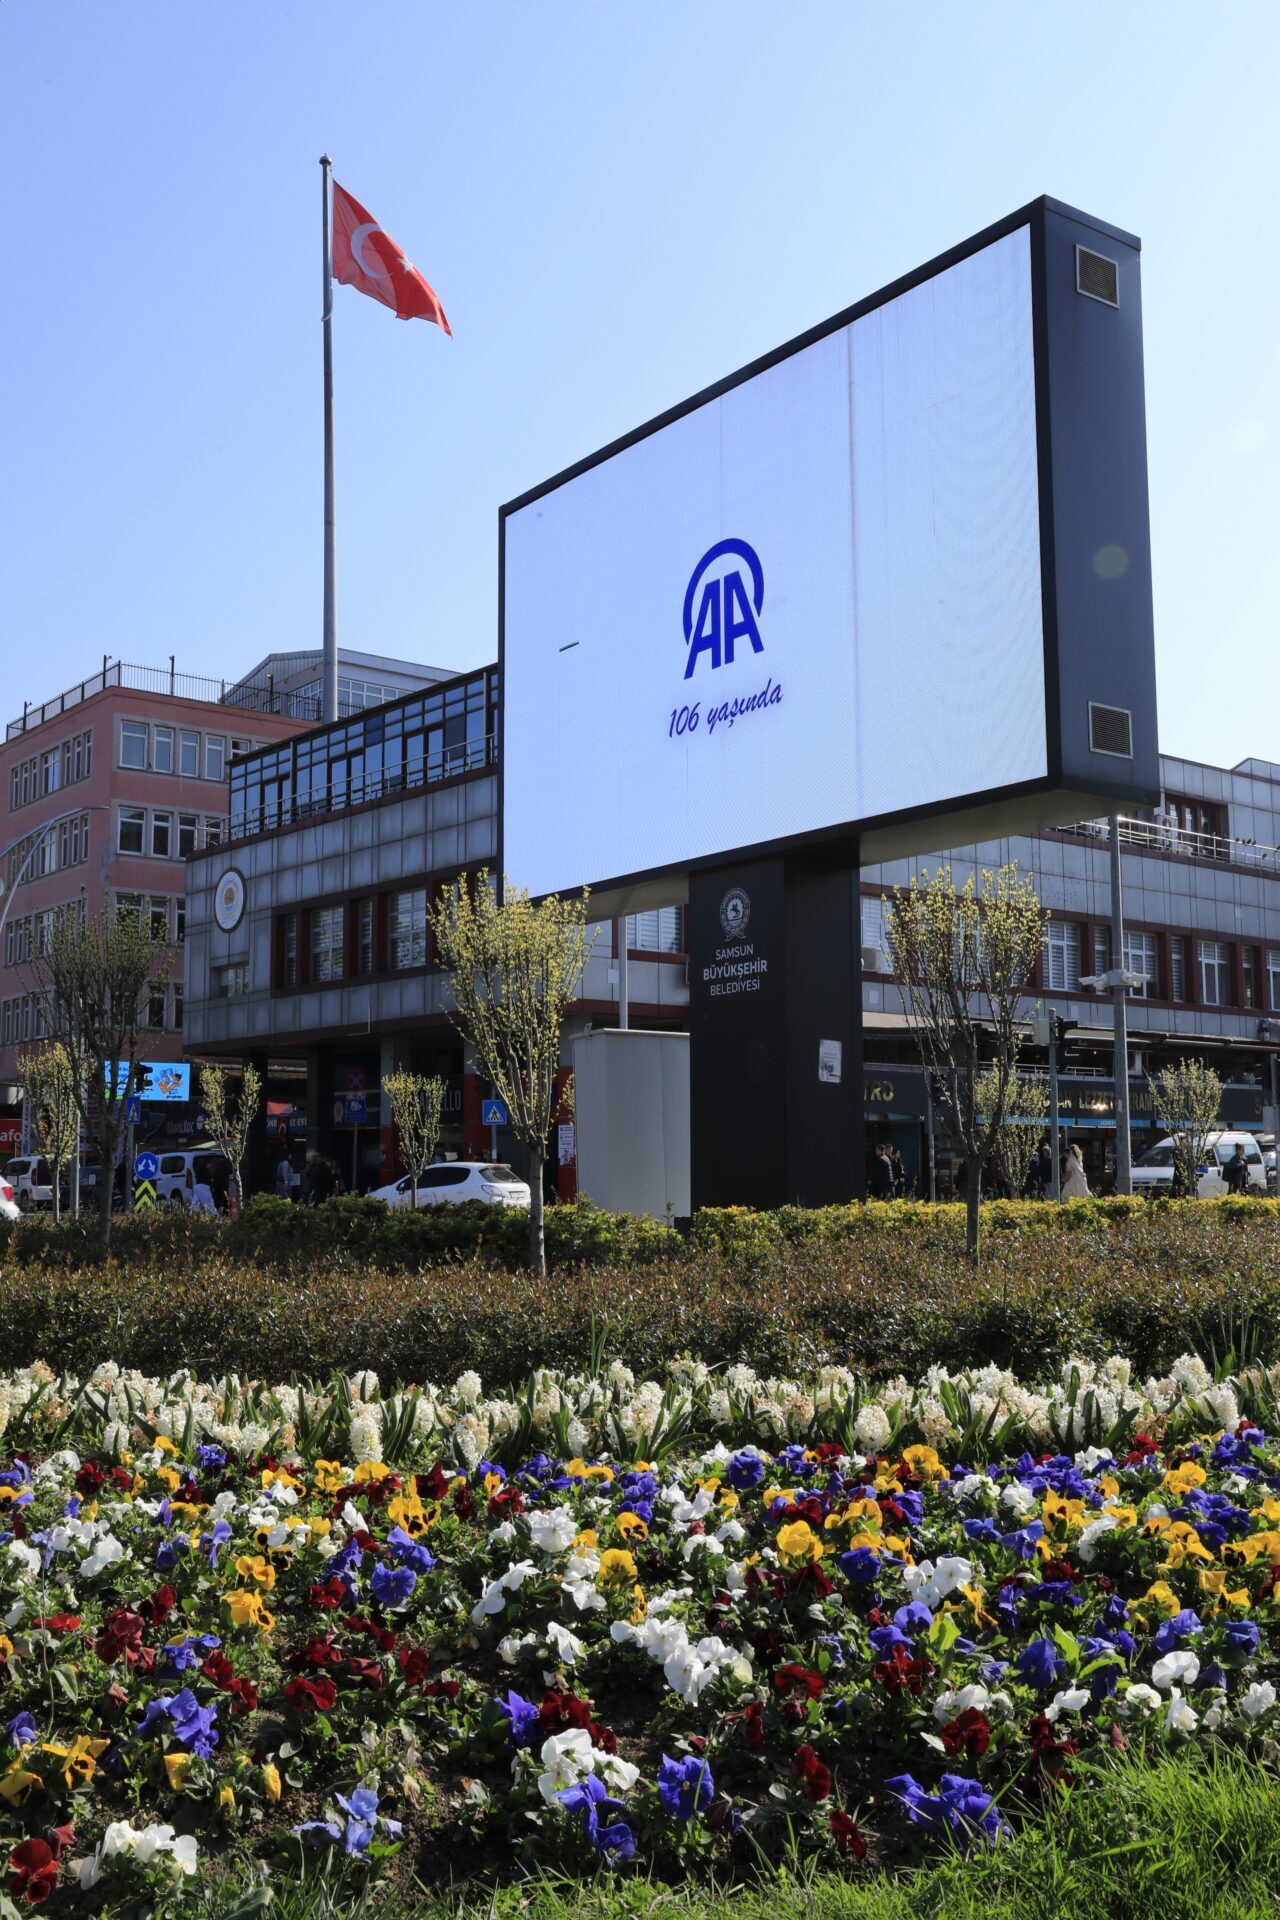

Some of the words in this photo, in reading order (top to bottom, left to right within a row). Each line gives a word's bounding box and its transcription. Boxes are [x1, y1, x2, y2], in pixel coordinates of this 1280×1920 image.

[684, 570, 765, 680] AA
[669, 701, 701, 738] 106
[707, 677, 784, 735] yaşında
[715, 943, 754, 961] SAMSUN
[703, 956, 768, 981] BÜYÜKŞEHİR
[710, 975, 760, 996] BELEDİYESİ
[0, 1128, 22, 1142] afo
